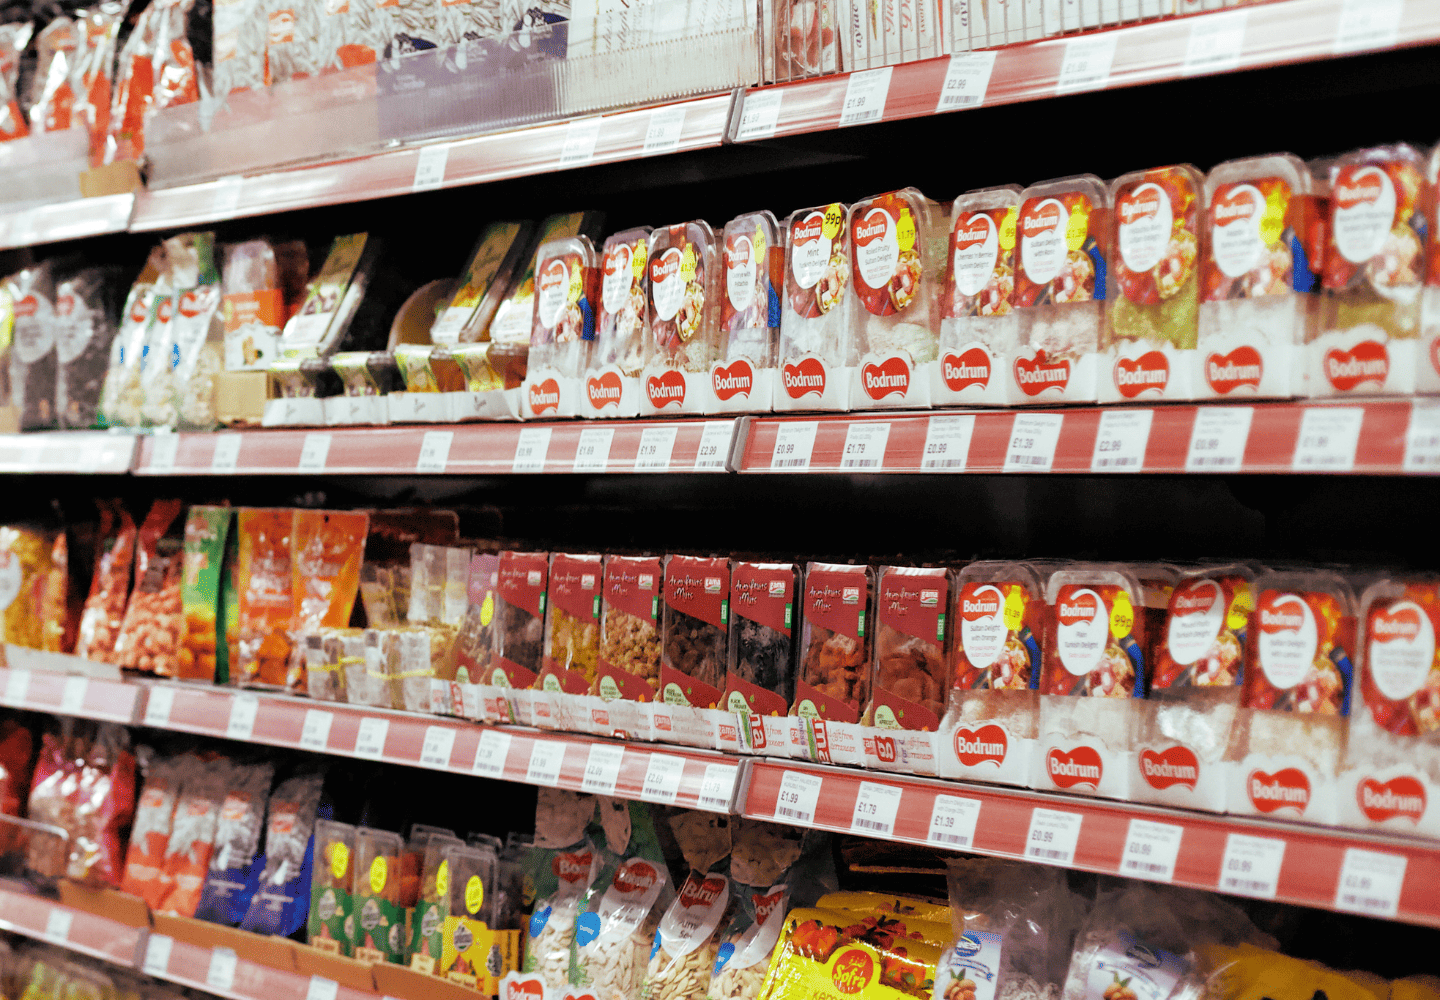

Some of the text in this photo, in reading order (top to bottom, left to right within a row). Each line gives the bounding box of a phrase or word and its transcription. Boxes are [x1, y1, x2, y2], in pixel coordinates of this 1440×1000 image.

[825, 212, 841, 228] 99p
[1024, 214, 1058, 229] Bodrum
[794, 225, 821, 240] Bodrum
[856, 223, 885, 239] Bodrum
[957, 229, 987, 242] Bodrum
[652, 258, 679, 277] Bodrum
[945, 363, 988, 381] Bodrum
[1018, 366, 1067, 385] Bodrum
[1118, 364, 1166, 385] Bodrum
[1210, 360, 1260, 381] Bodrum
[715, 373, 750, 391] Bodrum
[785, 371, 823, 388] Bodrum
[866, 371, 907, 389] Bodrum
[530, 391, 558, 407] Bodrum
[589, 384, 620, 400] Bodrum
[649, 383, 684, 400] Bodrum
[700, 445, 717, 455] £2.99
[776, 444, 794, 454] £0.99
[846, 443, 866, 453] £1.79
[927, 443, 947, 454] £0.99
[921, 591, 938, 600] gama
[963, 599, 997, 612] Bodrum
[1060, 603, 1095, 617] Bodrum
[1114, 614, 1132, 631] 99p
[958, 736, 1004, 756] Bodrum
[1051, 757, 1100, 779] Bodrum
[1143, 757, 1196, 779] Bodrum
[781, 790, 799, 804] £1.99
[1252, 778, 1308, 803] Bodrum
[1363, 787, 1423, 812] Bodrum
[858, 801, 877, 815] £1.79
[934, 815, 955, 828] £1.39
[1032, 829, 1054, 843] £0.99
[833, 964, 867, 989] Sofra
